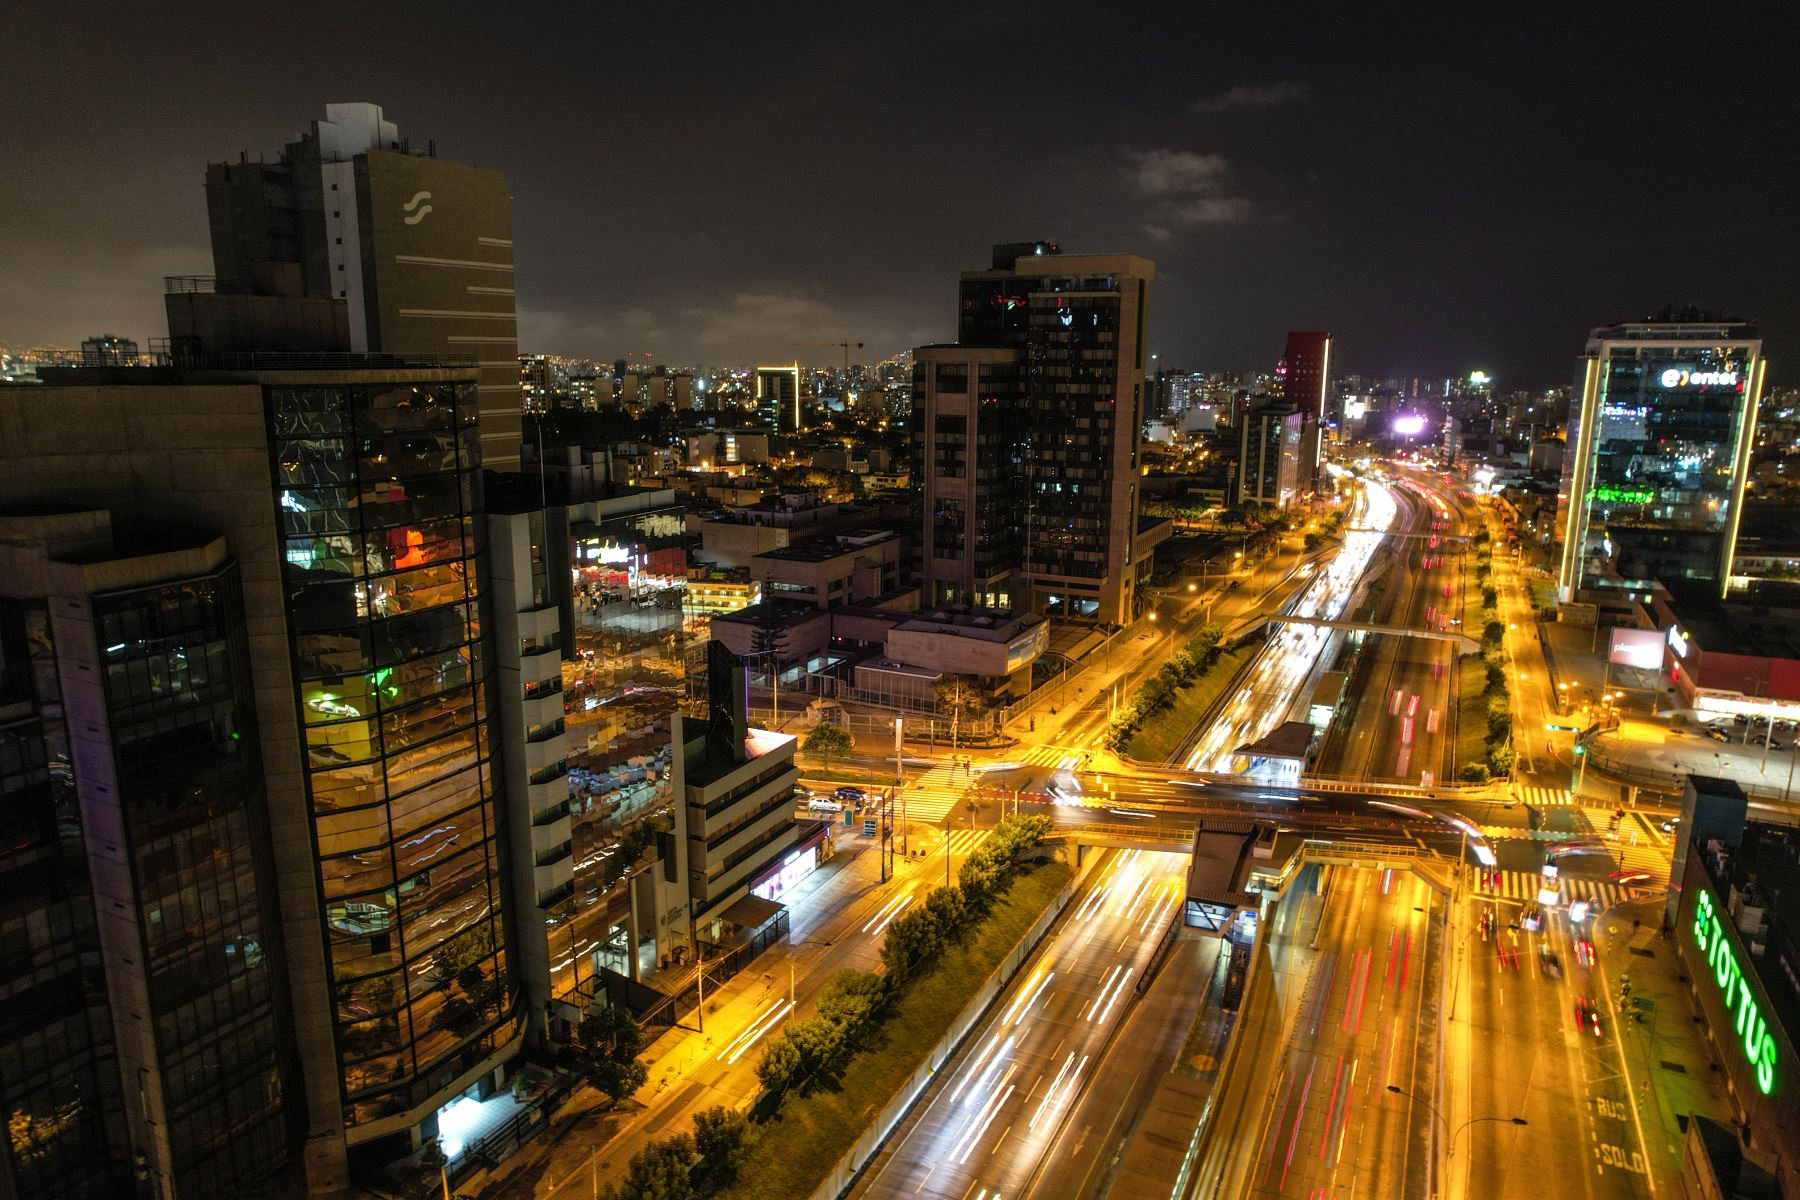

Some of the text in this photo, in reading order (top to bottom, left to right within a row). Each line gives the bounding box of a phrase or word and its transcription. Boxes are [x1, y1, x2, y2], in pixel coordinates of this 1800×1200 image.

[1690, 371, 1738, 386] entel
[1708, 915, 1777, 1095] TOTTUS
[1596, 1097, 1627, 1122] BUS
[1600, 1143, 1645, 1174] SOLO
